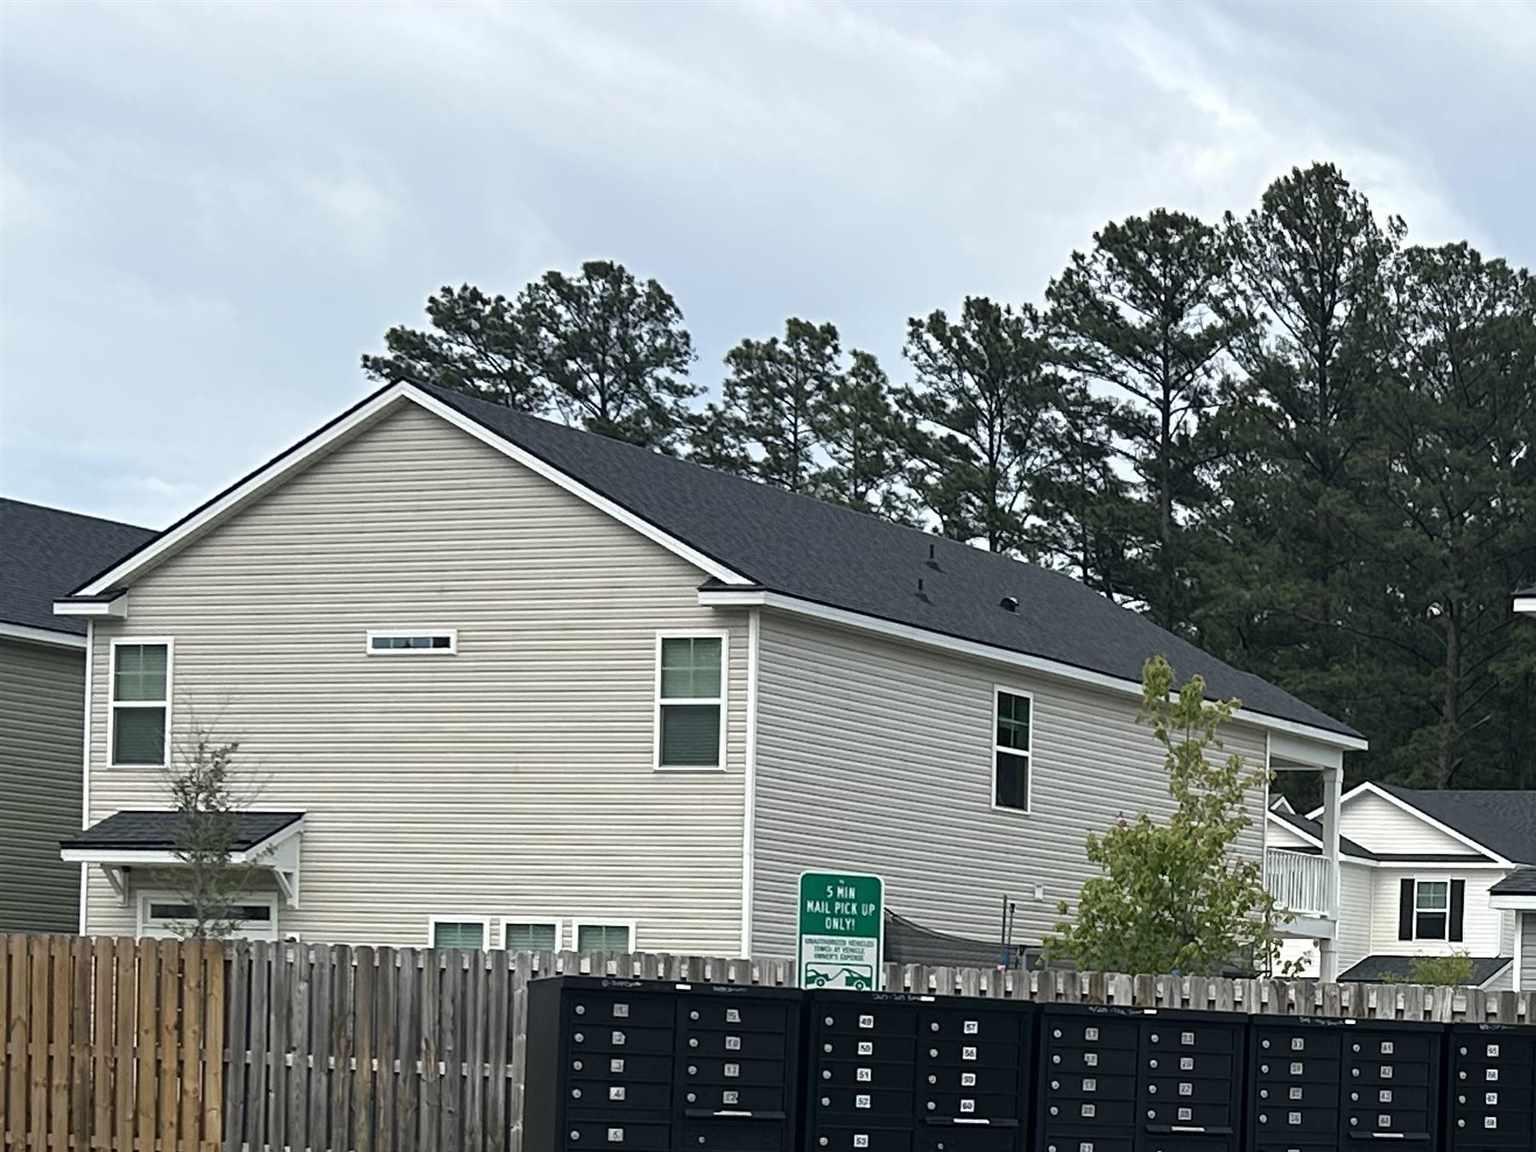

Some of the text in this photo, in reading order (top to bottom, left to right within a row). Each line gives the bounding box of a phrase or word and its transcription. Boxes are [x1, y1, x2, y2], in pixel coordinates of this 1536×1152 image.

[826, 885, 856, 900] 5 MIN
[806, 900, 876, 917] MAIL PICK UP
[825, 916, 856, 931] ONLY!
